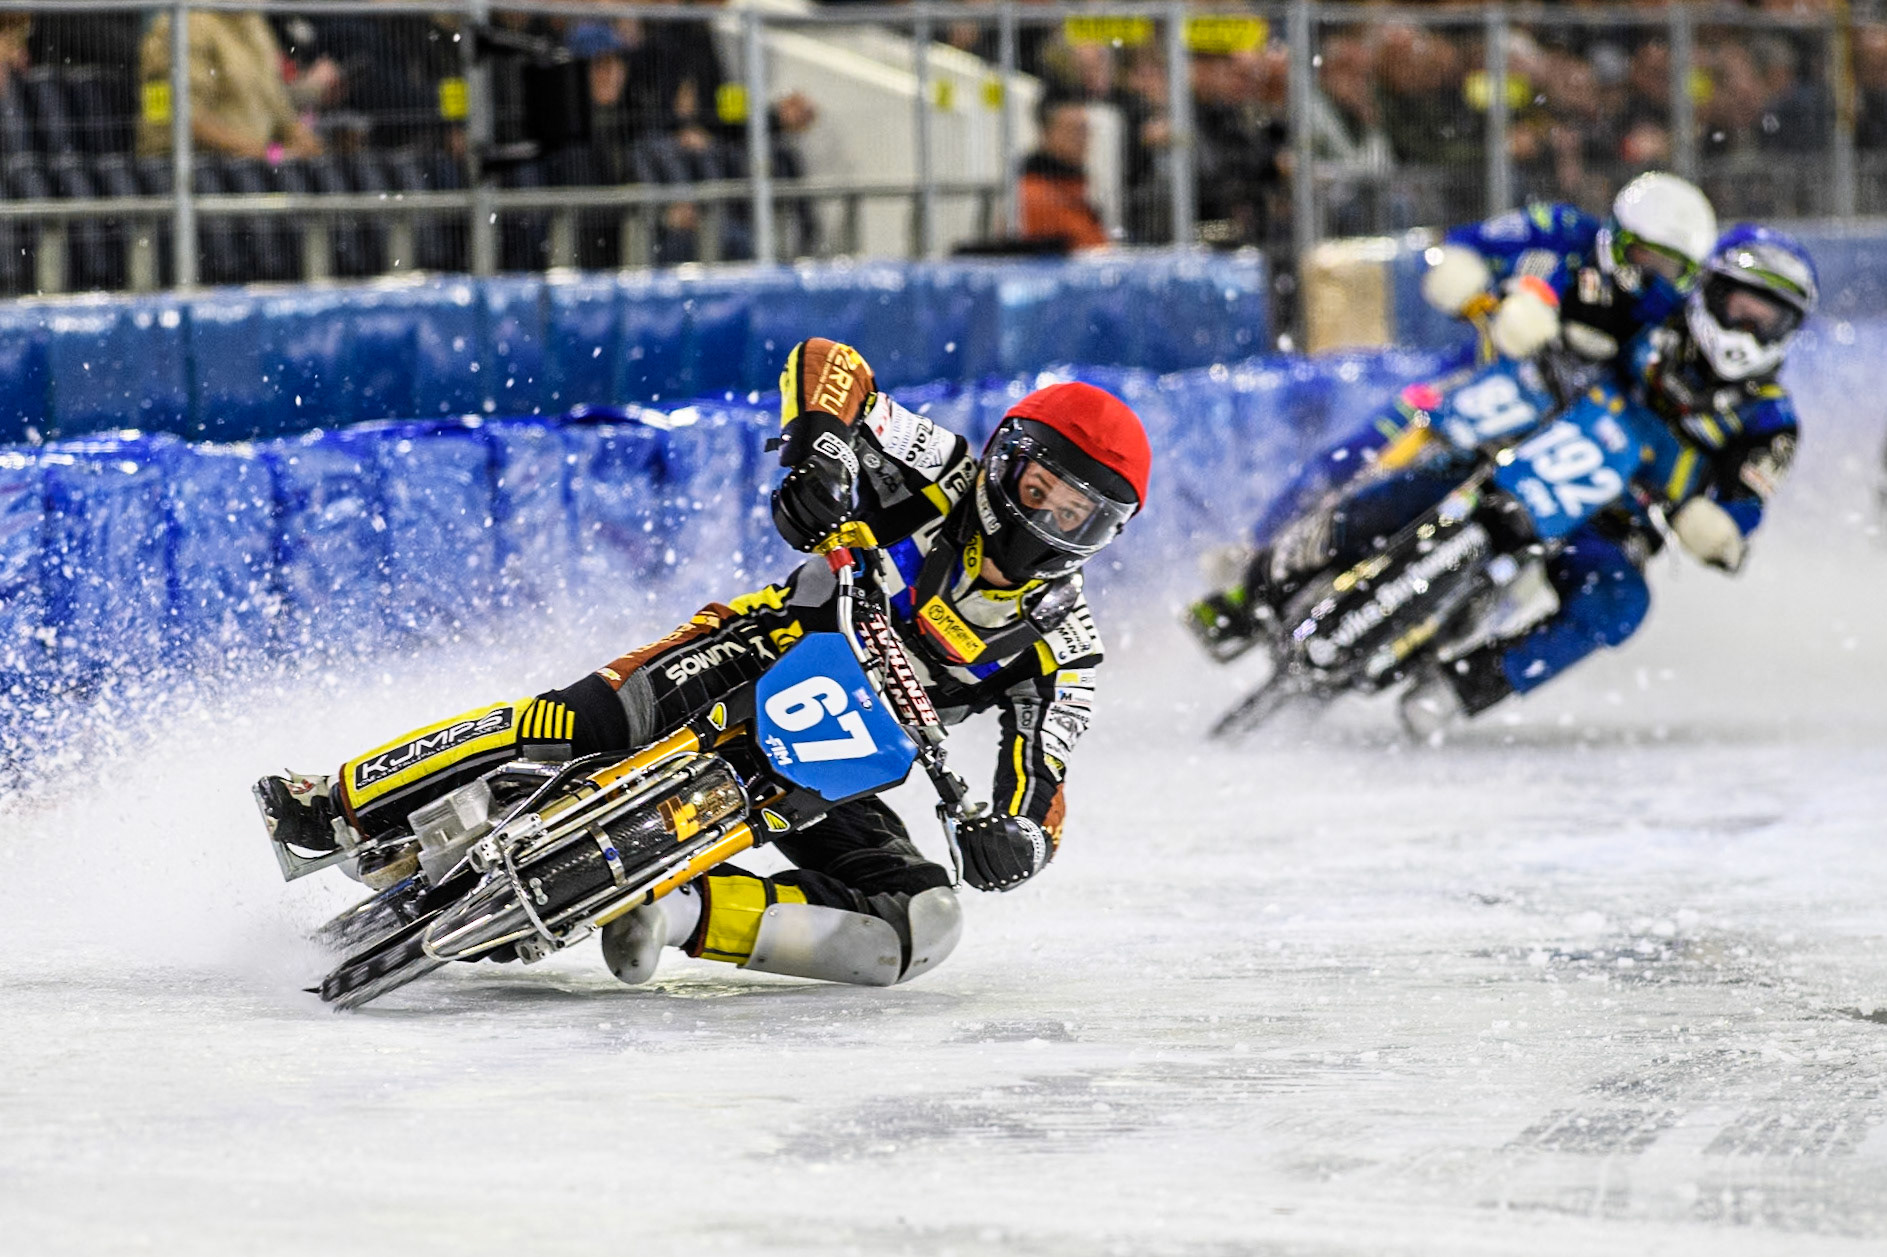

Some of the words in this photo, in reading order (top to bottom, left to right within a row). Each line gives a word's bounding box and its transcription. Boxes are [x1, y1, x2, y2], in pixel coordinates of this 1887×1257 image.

[1517, 420, 1623, 518] 192
[869, 612, 941, 727] RENTHAL
[361, 709, 504, 780] KJMPS
[764, 734, 794, 766] FIM
[765, 675, 879, 763] 67
